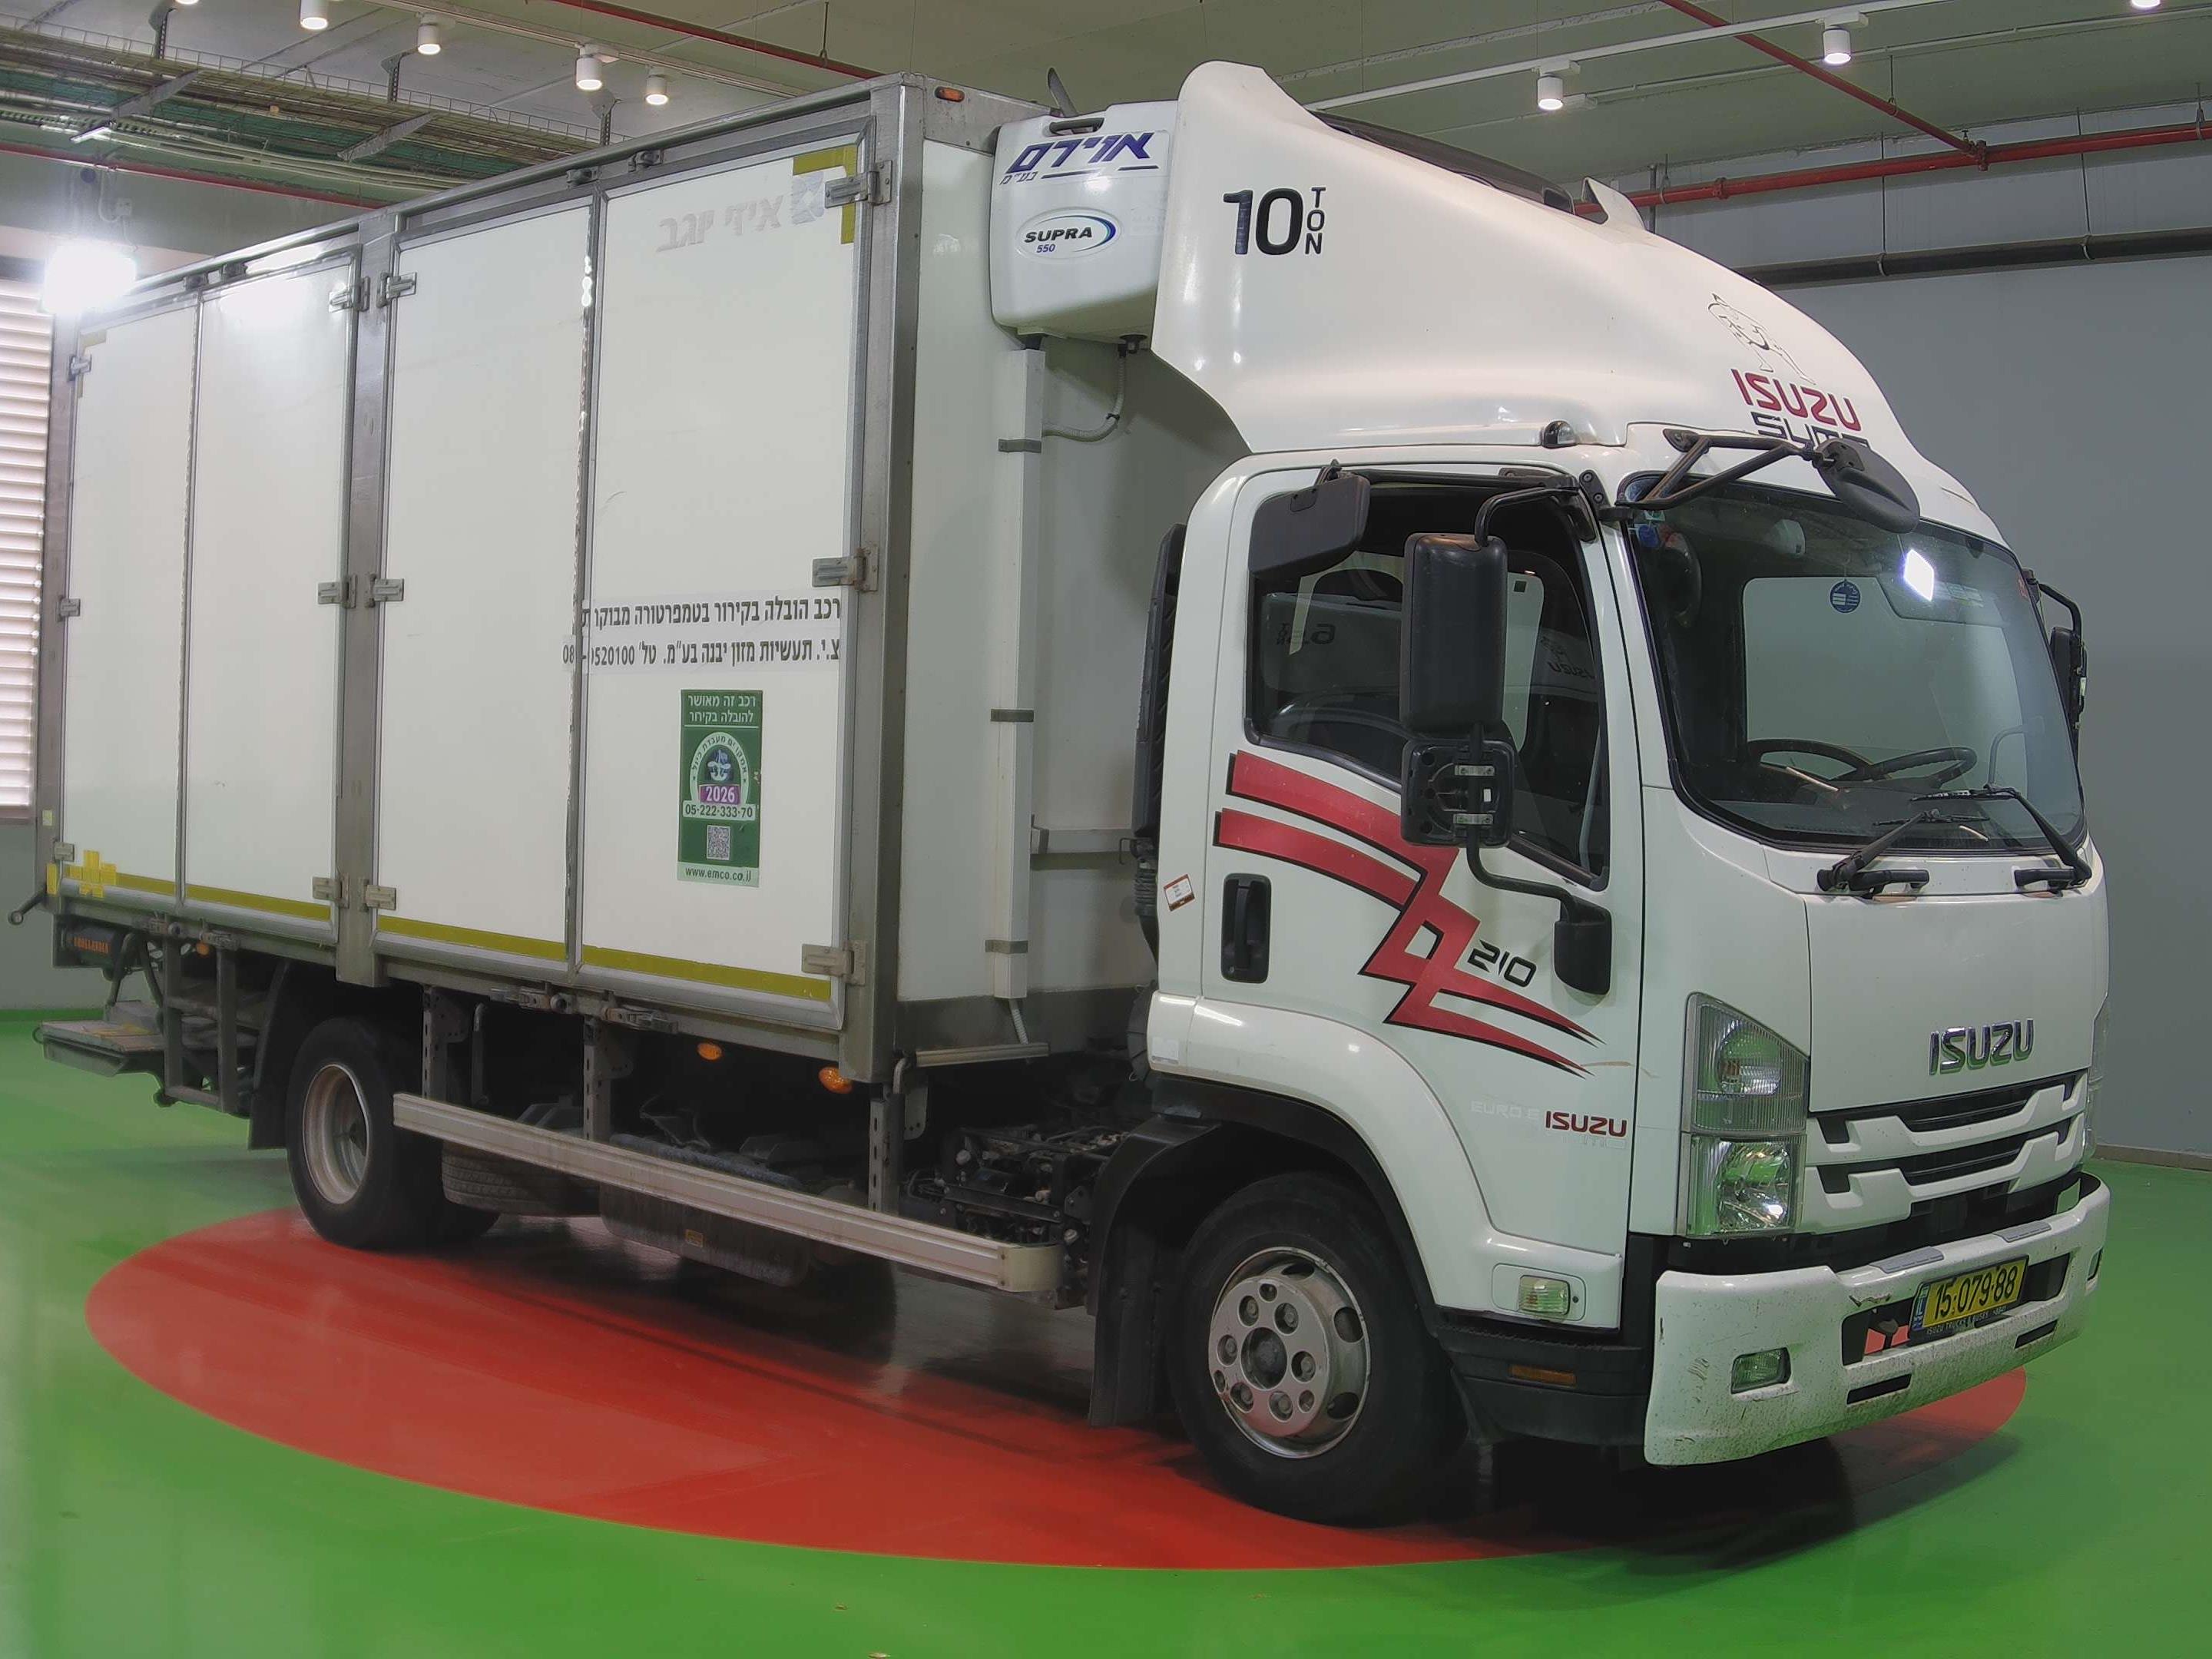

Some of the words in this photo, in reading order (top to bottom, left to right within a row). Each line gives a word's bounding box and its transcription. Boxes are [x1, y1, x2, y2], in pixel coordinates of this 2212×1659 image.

[1223, 187, 1303, 256] 10
[1305, 187, 1326, 255] TON
[1024, 227, 1093, 243] SUPRA
[1036, 243, 1055, 253] 550
[1730, 369, 1861, 431] ISUZU
[634, 602, 710, 624] בטמפרטורה
[714, 601, 760, 625] בקירור
[765, 595, 809, 621] הובלה
[814, 598, 841, 619] רכב
[701, 642, 727, 663] יבנה
[731, 641, 755, 667] מזון
[759, 639, 813, 662] תעשיות
[687, 695, 720, 707] מאושר
[724, 695, 735, 707] זה
[738, 695, 756, 707] רכב
[689, 711, 717, 724] בקירור
[721, 709, 753, 723] להובלה
[706, 786, 735, 803] 2026
[685, 867, 751, 882] www.emco.co.il
[1467, 939, 1537, 988] 210
[1929, 1018, 2035, 1075] ISUZU
[1545, 1111, 1628, 1137] ISUZU
